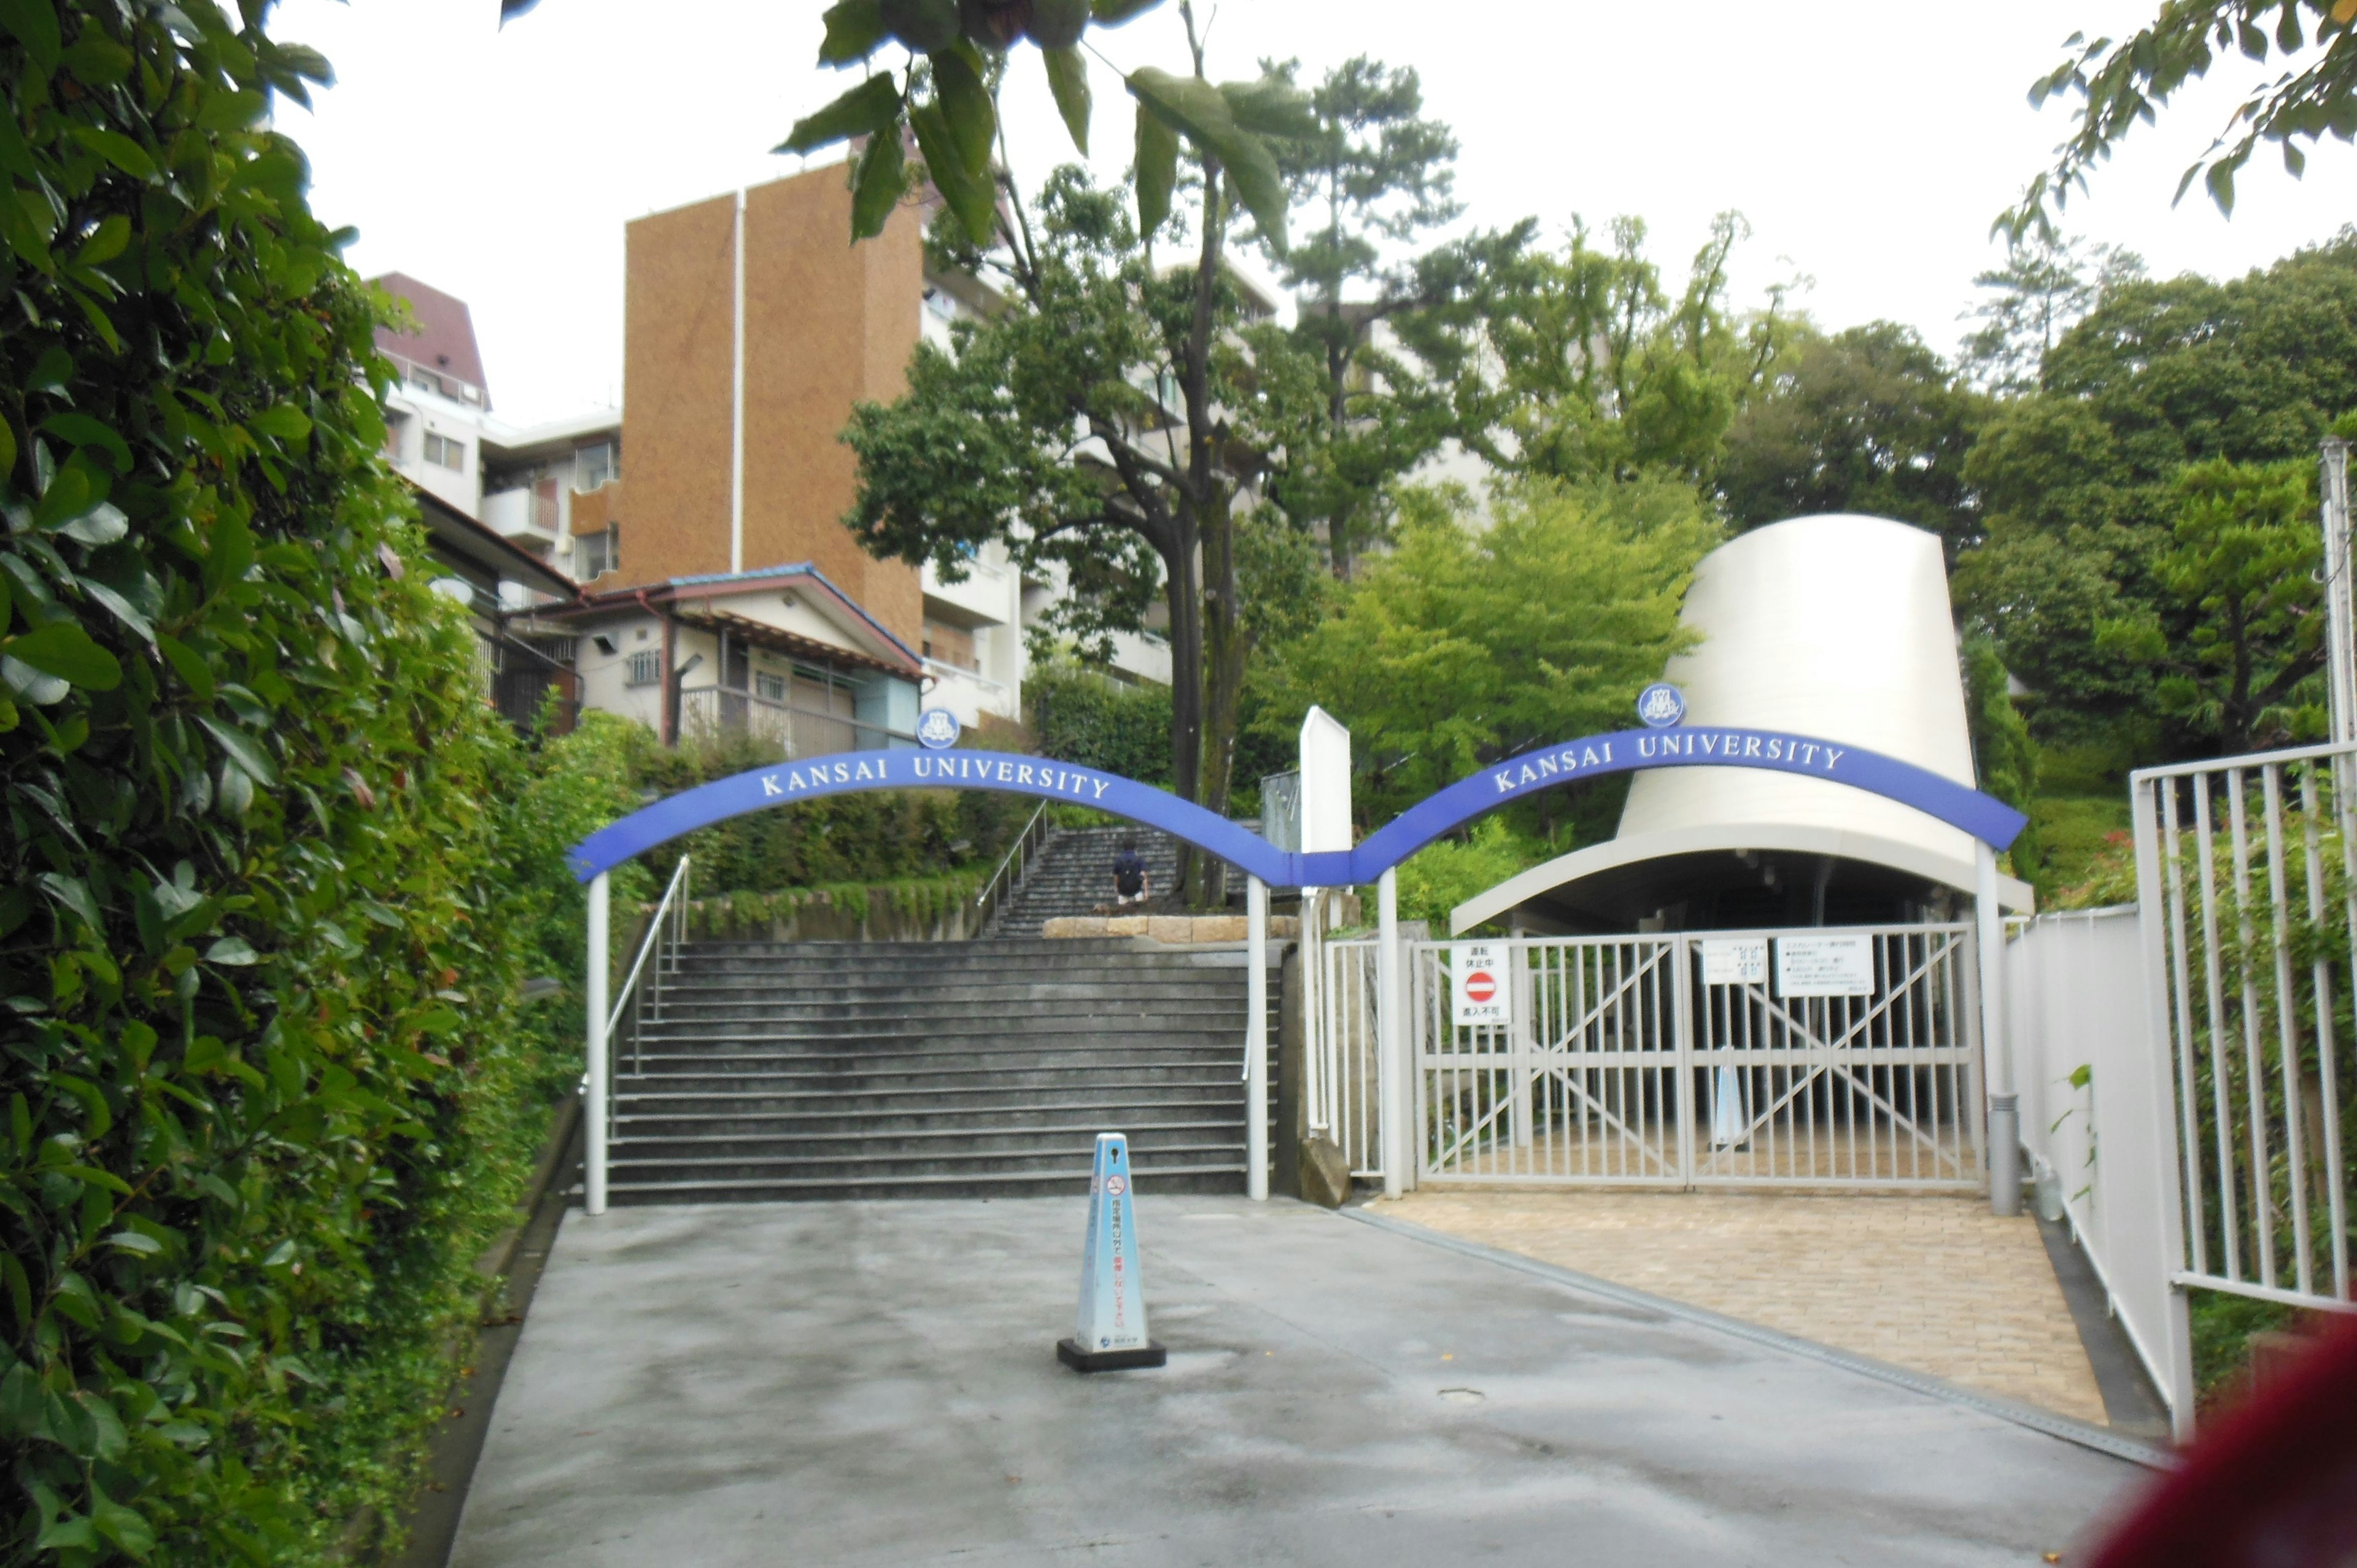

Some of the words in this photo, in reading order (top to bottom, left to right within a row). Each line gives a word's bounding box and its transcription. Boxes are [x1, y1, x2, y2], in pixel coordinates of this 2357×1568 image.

[1494, 743, 1614, 794] KANSAI
[1638, 734, 1844, 769] UNIVERSITY
[761, 759, 886, 796] KANSAI
[913, 757, 1110, 798] UNIVERSITY
[1466, 959, 1493, 968] 休止中
[1463, 1007, 1499, 1016] 進入不可
